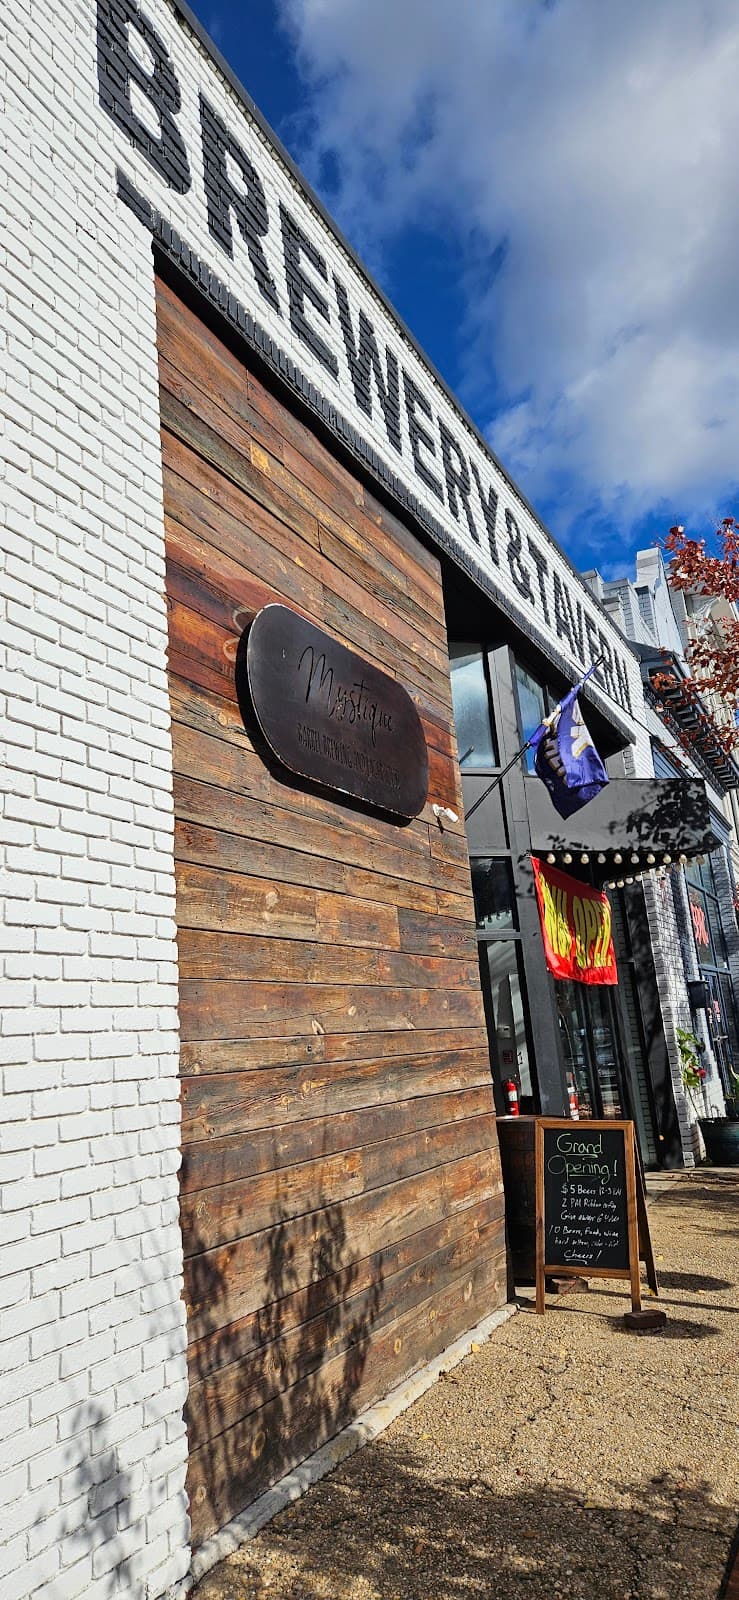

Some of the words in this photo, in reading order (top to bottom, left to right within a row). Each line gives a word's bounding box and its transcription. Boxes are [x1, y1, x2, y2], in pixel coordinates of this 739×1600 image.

[97, 0, 499, 567] BREWERY
[528, 540, 633, 718] TAVERN
[297, 645, 393, 747] Mystique
[556, 1133, 603, 1154] Grand
[577, 1184, 596, 1195] Beers
[561, 1199, 567, 1208] 2
[570, 1199, 582, 1208] PM
